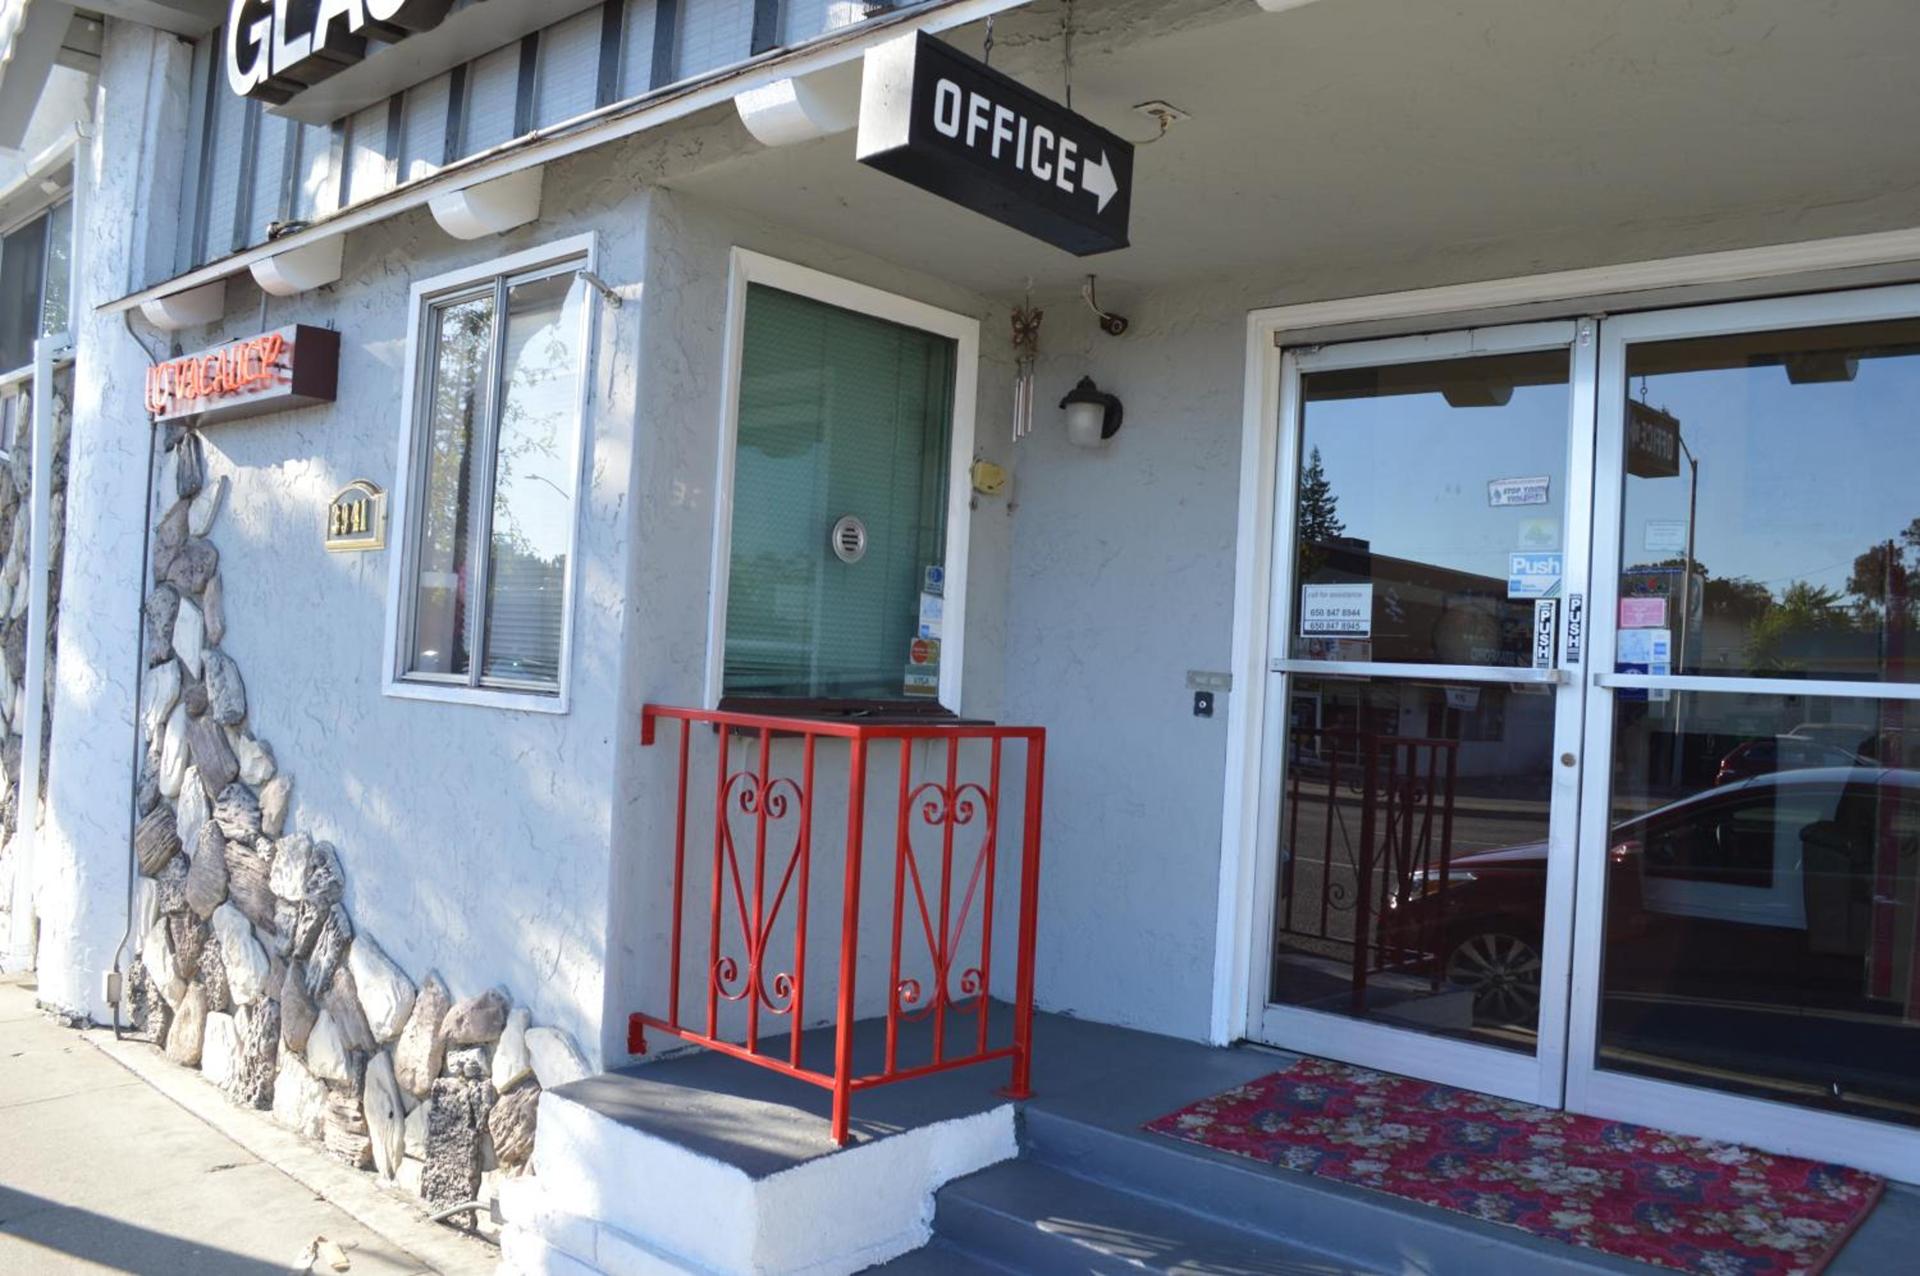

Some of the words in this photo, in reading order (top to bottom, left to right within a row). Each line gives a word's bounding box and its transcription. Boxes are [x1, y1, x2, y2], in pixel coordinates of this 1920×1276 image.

[933, 77, 1078, 194] OFFICE
[173, 332, 283, 399] VACANCY
[1512, 557, 1560, 575] Push
[1310, 608, 1324, 617] 650
[1537, 609, 1551, 659] PUSH
[1567, 598, 1581, 648] PUSH
